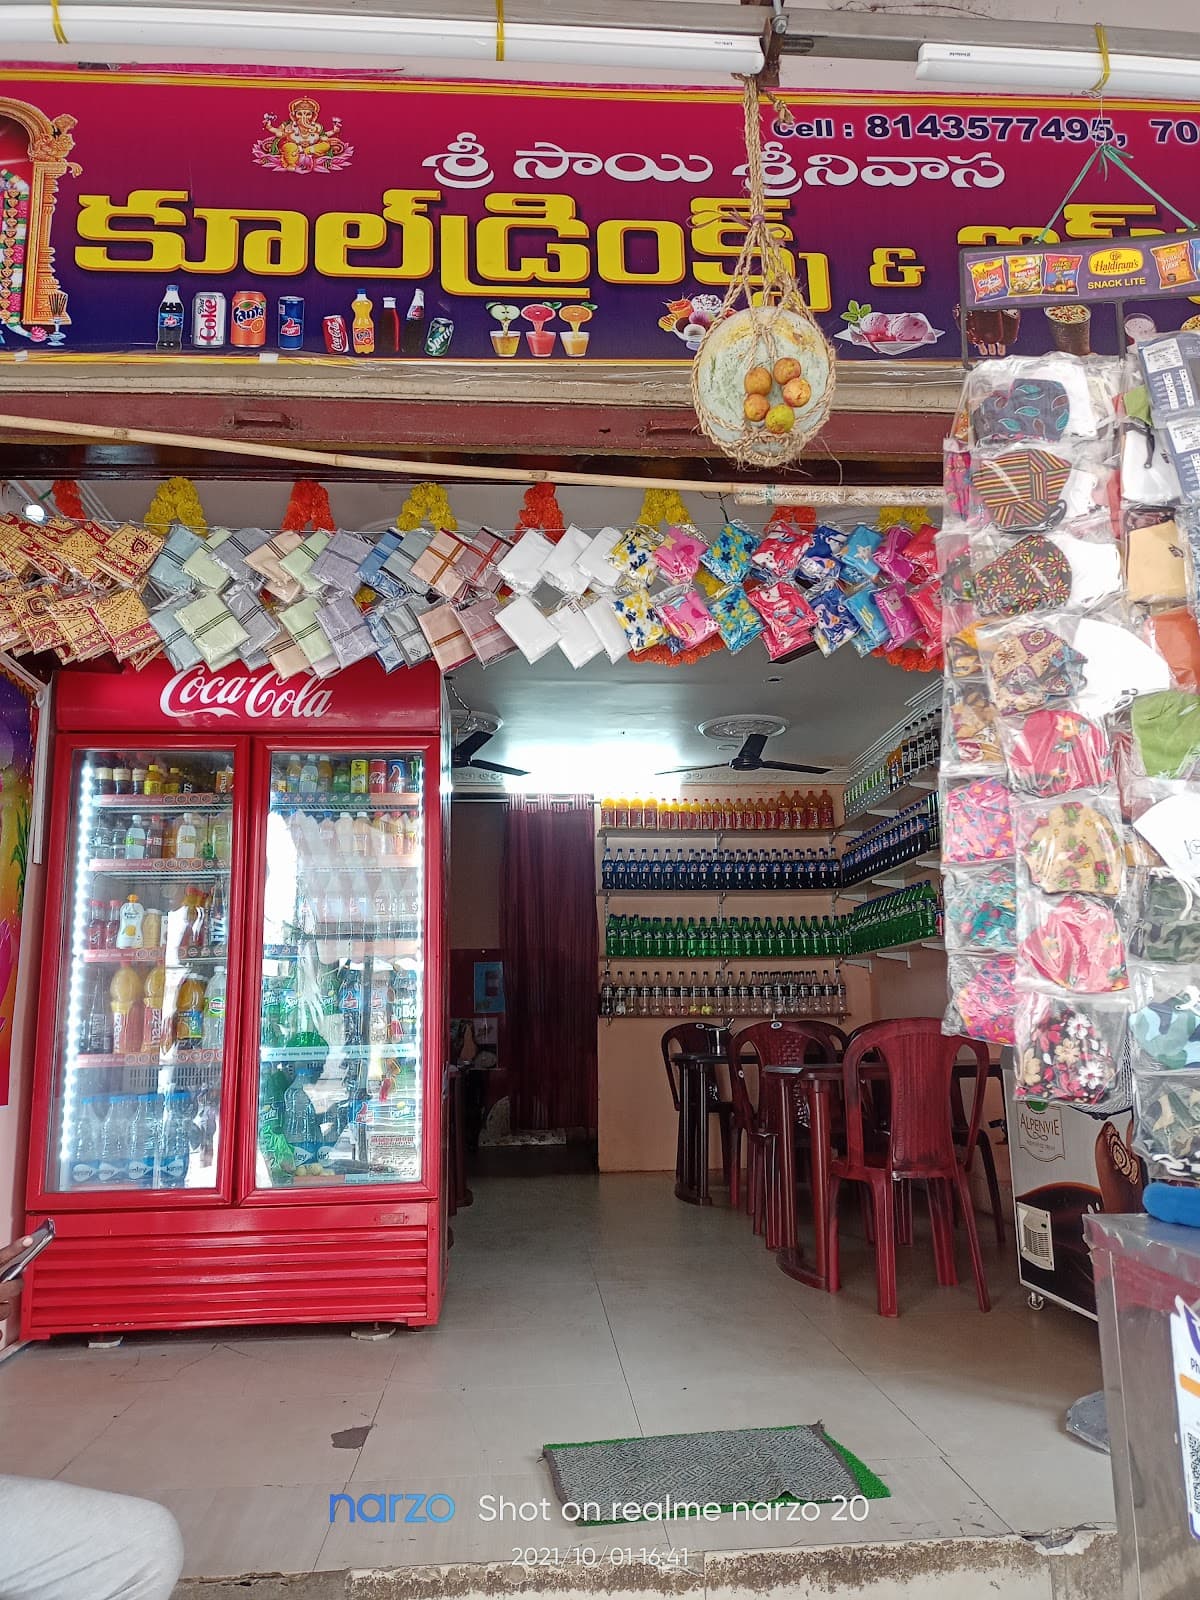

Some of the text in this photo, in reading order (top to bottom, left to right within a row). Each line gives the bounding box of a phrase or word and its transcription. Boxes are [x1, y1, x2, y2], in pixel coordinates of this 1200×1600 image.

[773, 117, 833, 138] Cell
[865, 114, 1128, 147] 8143577495,
[422, 132, 1006, 197] శ్రీ సాయి శ్రీనివాస
[869, 247, 926, 289] &
[1087, 277, 1147, 290] SNACK LITE
[199, 298, 217, 342] Coke
[159, 665, 333, 718] Coca-Cola
[1020, 1112, 1060, 1137] ALPENVIE
